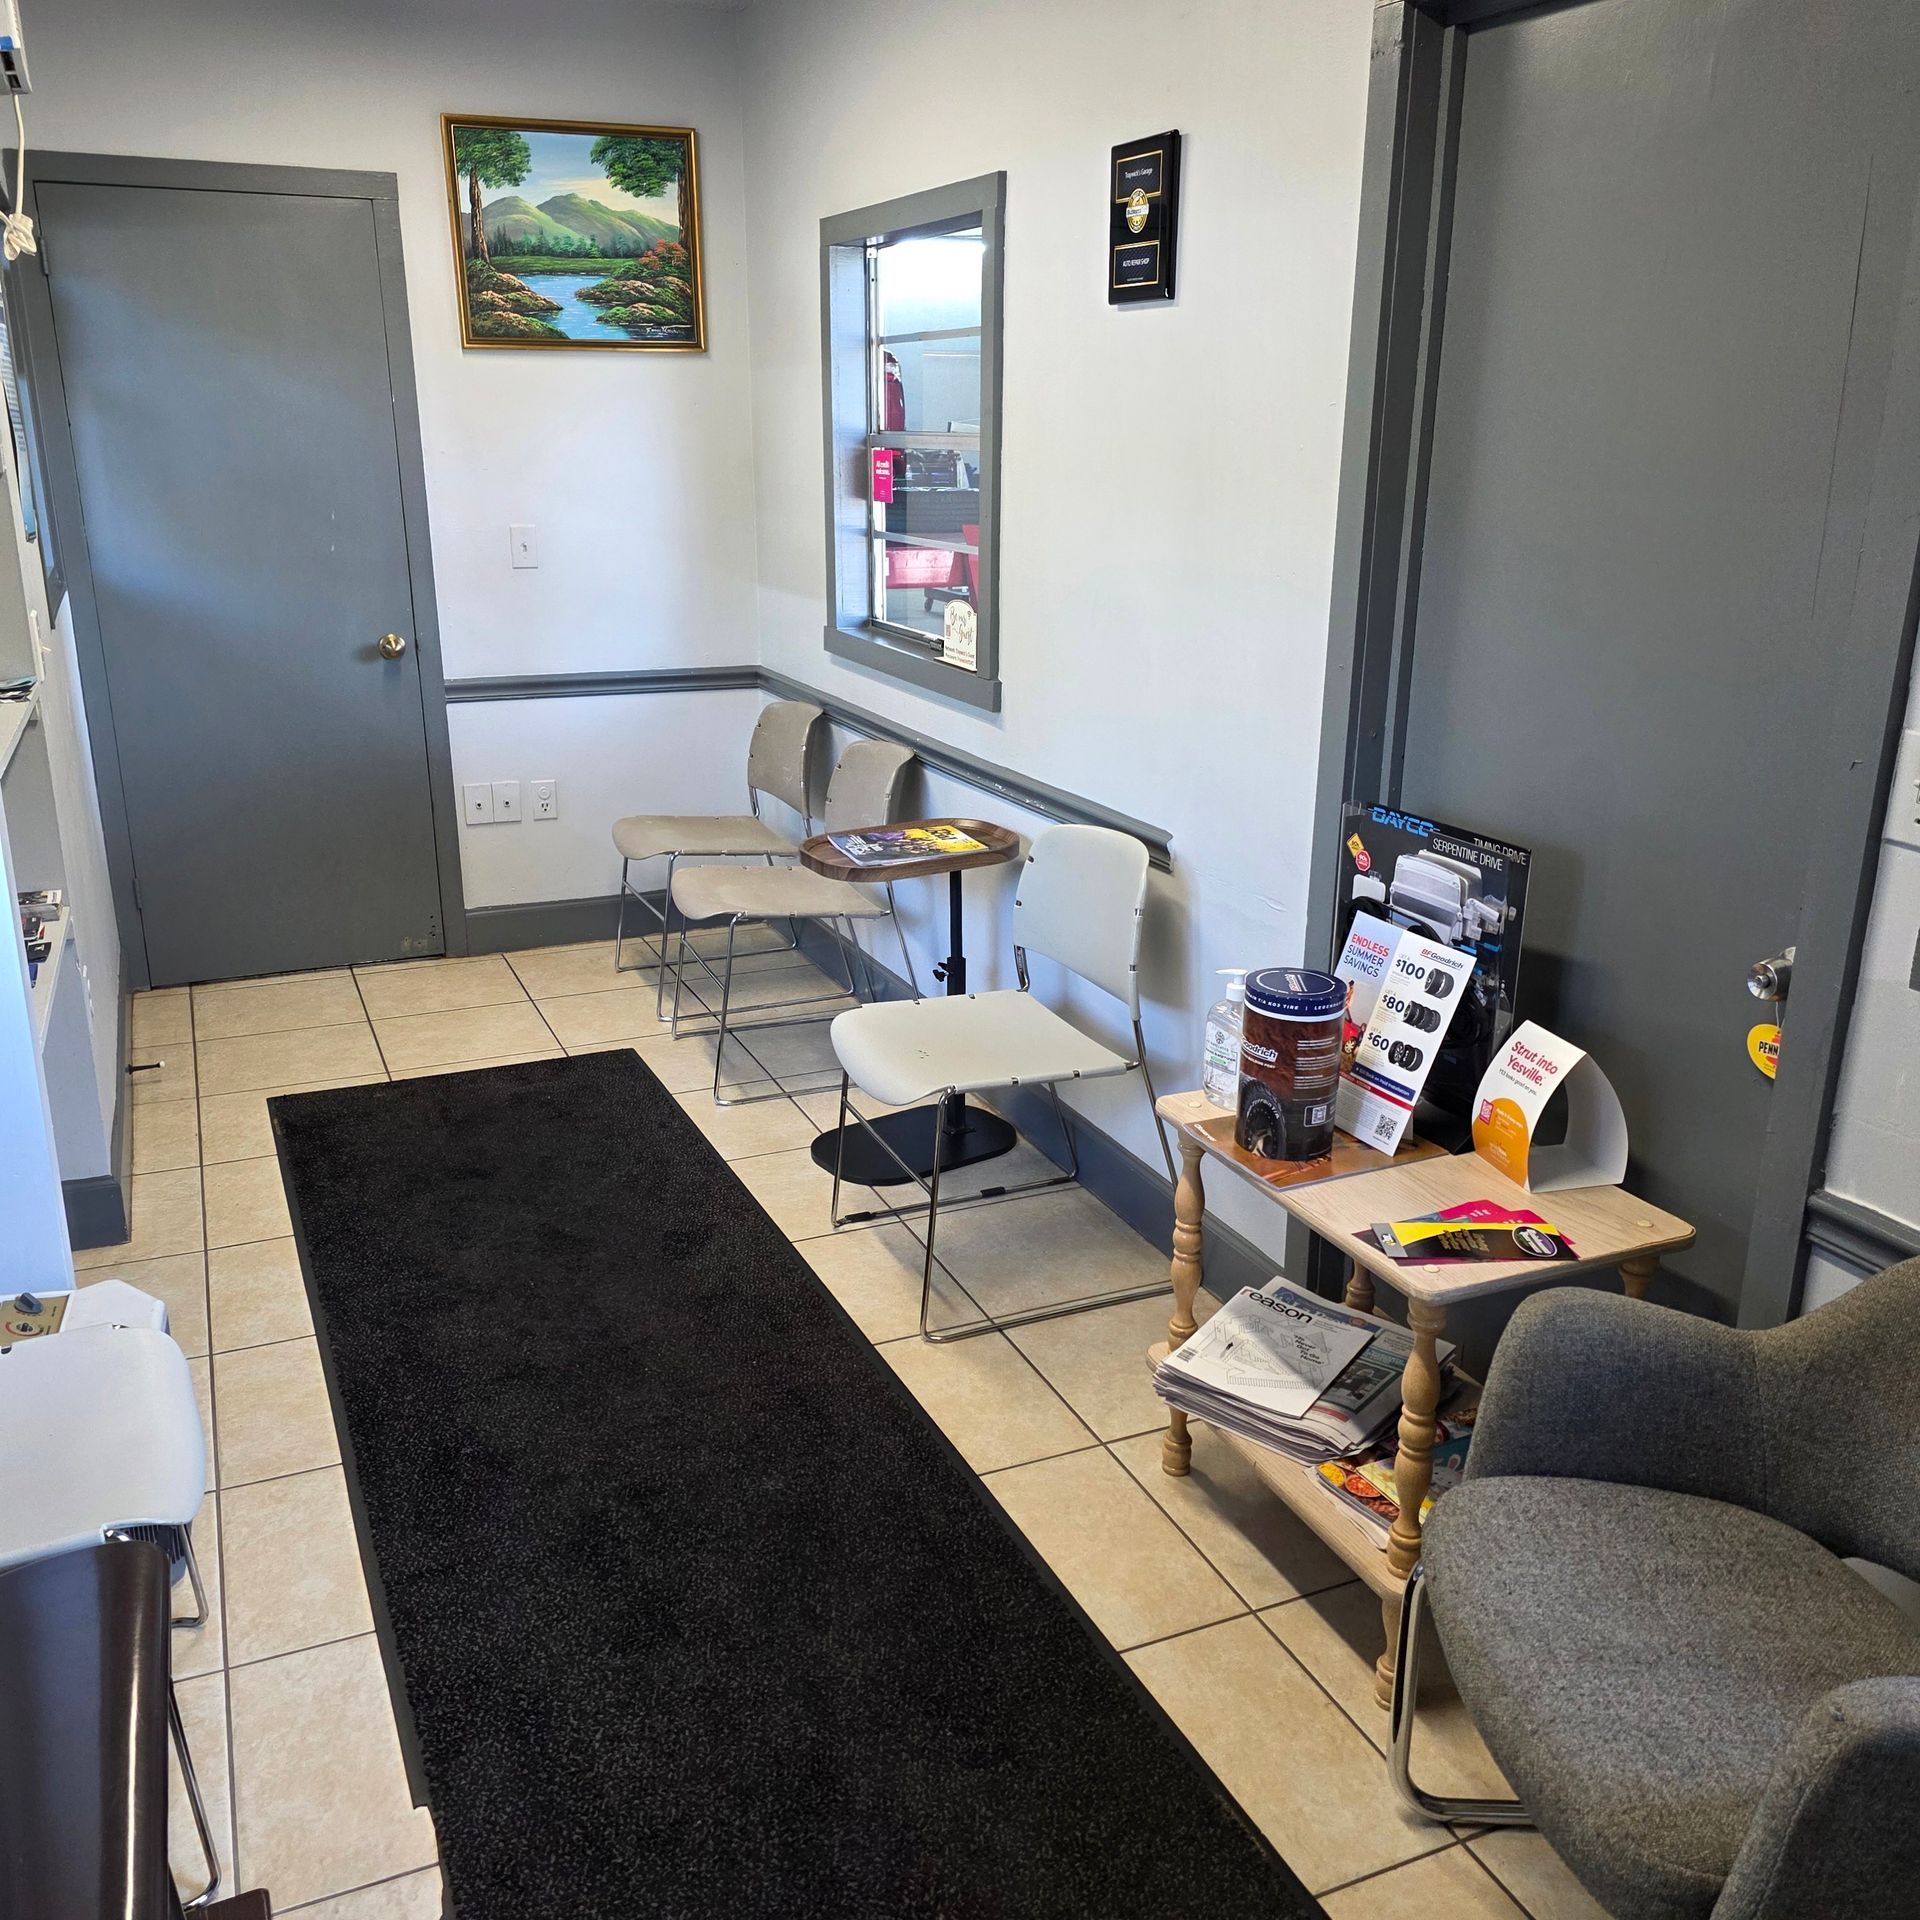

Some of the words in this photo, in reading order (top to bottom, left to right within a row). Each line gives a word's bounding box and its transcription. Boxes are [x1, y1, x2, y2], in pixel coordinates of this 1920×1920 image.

[1371, 806, 1434, 838] DAYCO
[1432, 837, 1479, 864] SERPENTINE
[1480, 853, 1503, 872] DRIVE
[1502, 846, 1527, 866] DRIVE
[1347, 944, 1385, 967] SUMMER
[1351, 933, 1390, 957] ENDLESS
[1343, 954, 1380, 978] SAVINGS
[1395, 959, 1425, 980] $100
[1421, 948, 1464, 970] BFGoodrich
[1382, 994, 1405, 1013] $80
[1367, 1032, 1390, 1051] $60
[1758, 1040, 1779, 1057] PENN
[1511, 1040, 1538, 1063] Strut
[1535, 1055, 1558, 1075] into
[1506, 1055, 1543, 1087] Yesville.
[1240, 1288, 1313, 1324] reason
